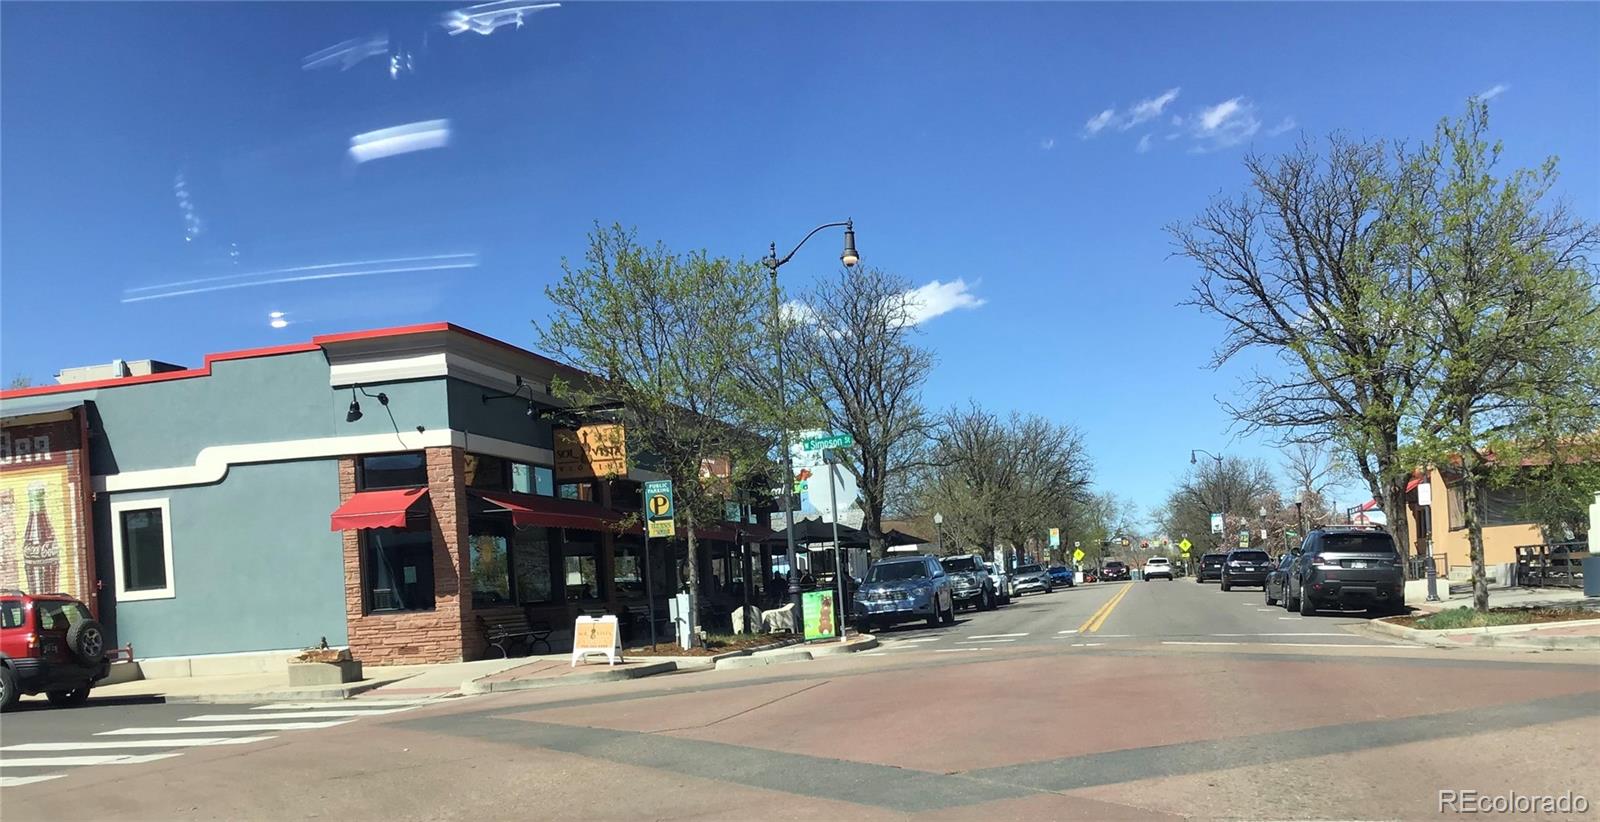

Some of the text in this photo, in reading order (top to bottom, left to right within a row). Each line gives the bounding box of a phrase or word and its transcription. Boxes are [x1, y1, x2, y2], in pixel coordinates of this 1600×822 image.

[810, 438, 843, 450] Simpson
[844, 436, 851, 444] St
[557, 445, 624, 459] SOL VISTA
[654, 496, 667, 516] P
